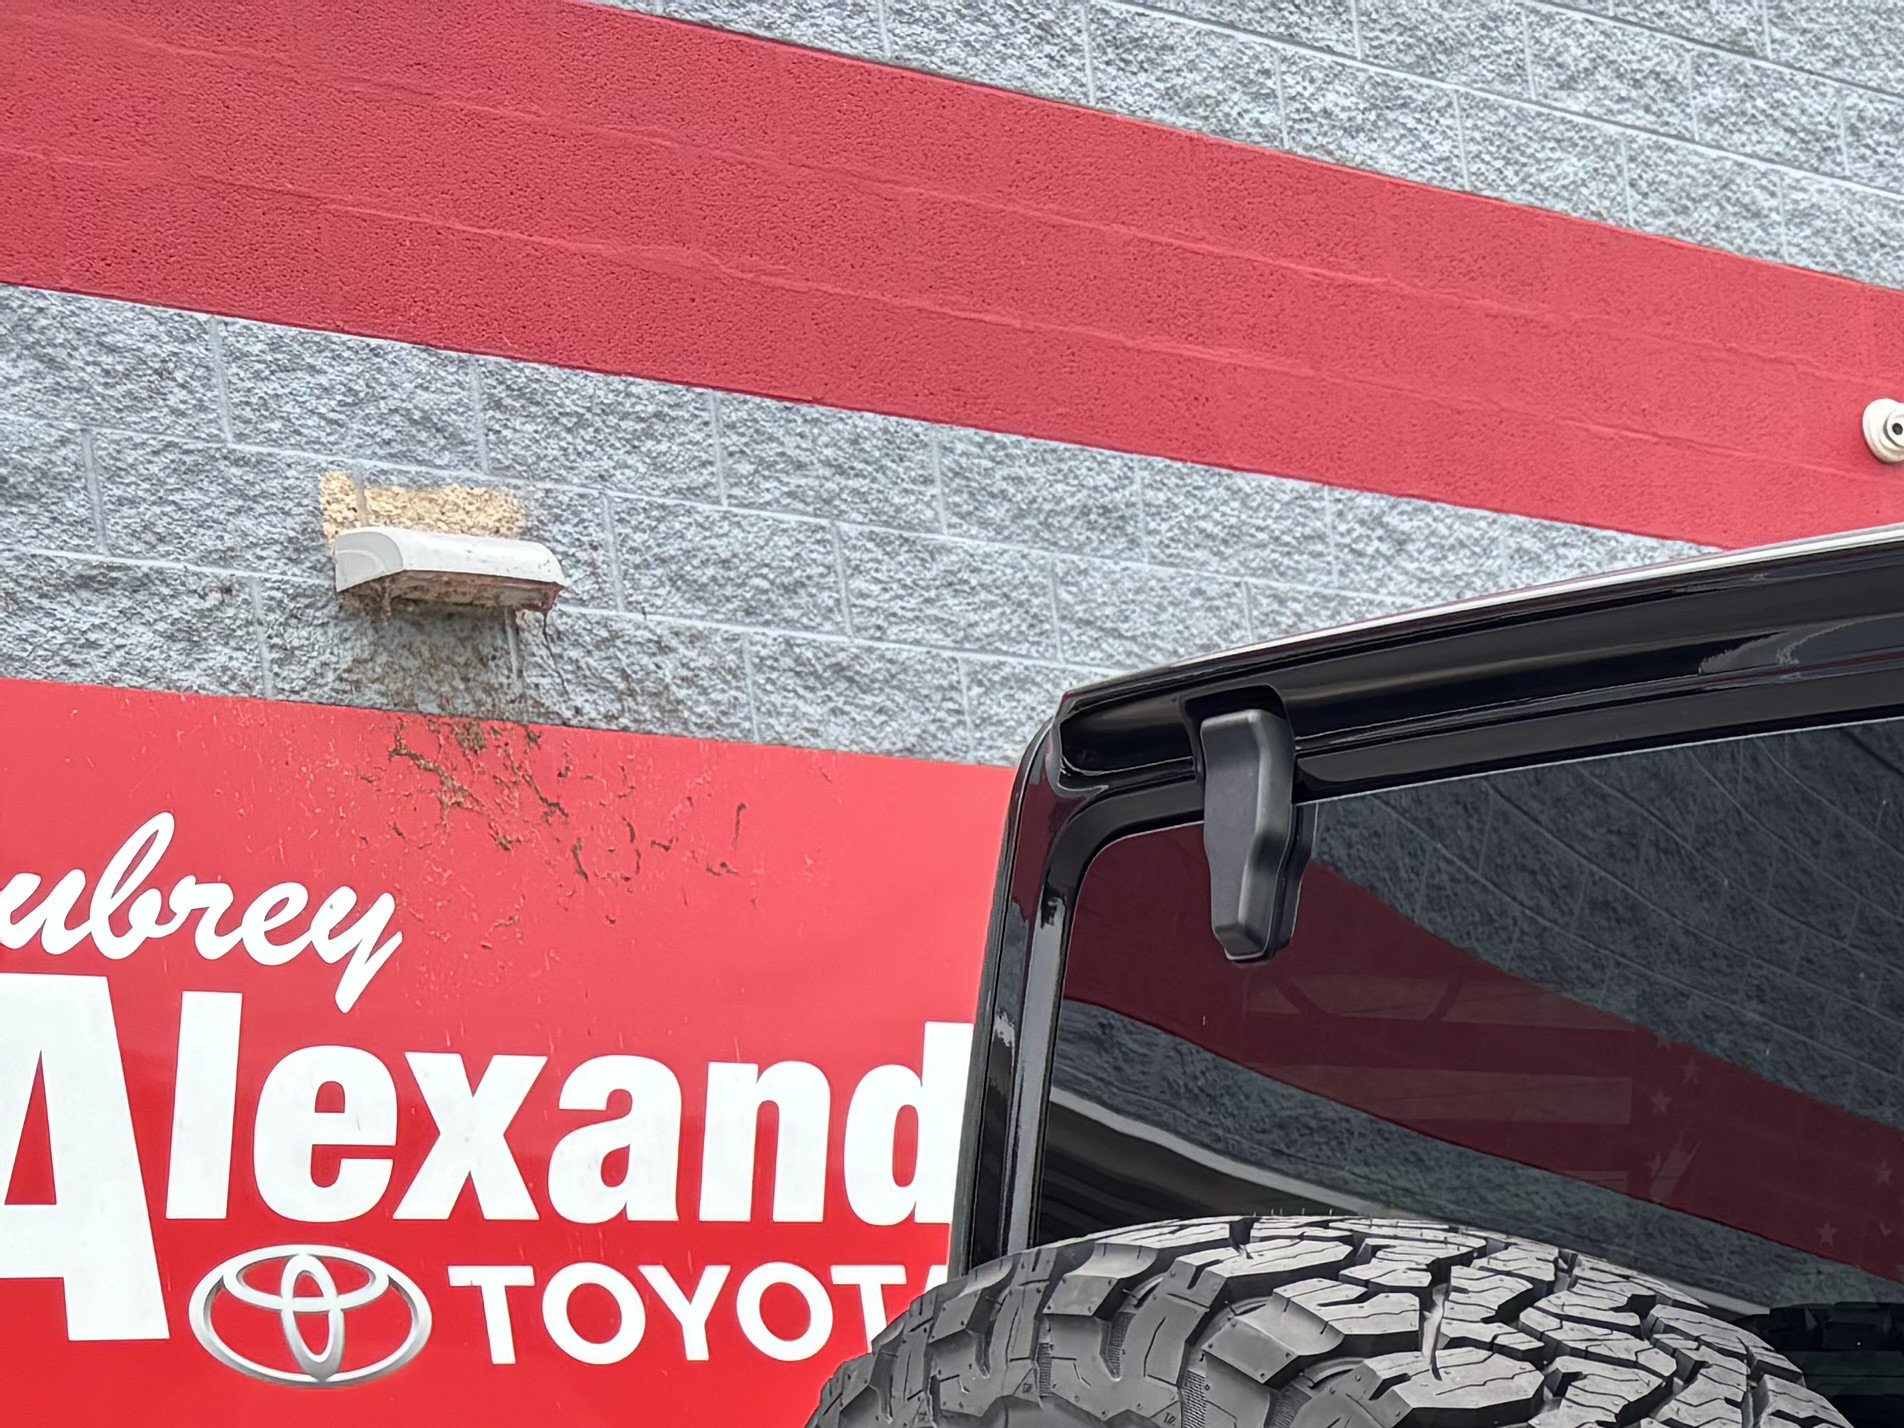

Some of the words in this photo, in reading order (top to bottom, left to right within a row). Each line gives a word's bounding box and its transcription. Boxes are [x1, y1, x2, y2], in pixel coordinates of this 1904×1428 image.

[0, 812, 402, 1014] ubrey
[0, 972, 975, 1342] Alexand
[448, 1262, 950, 1366] TOYOT
